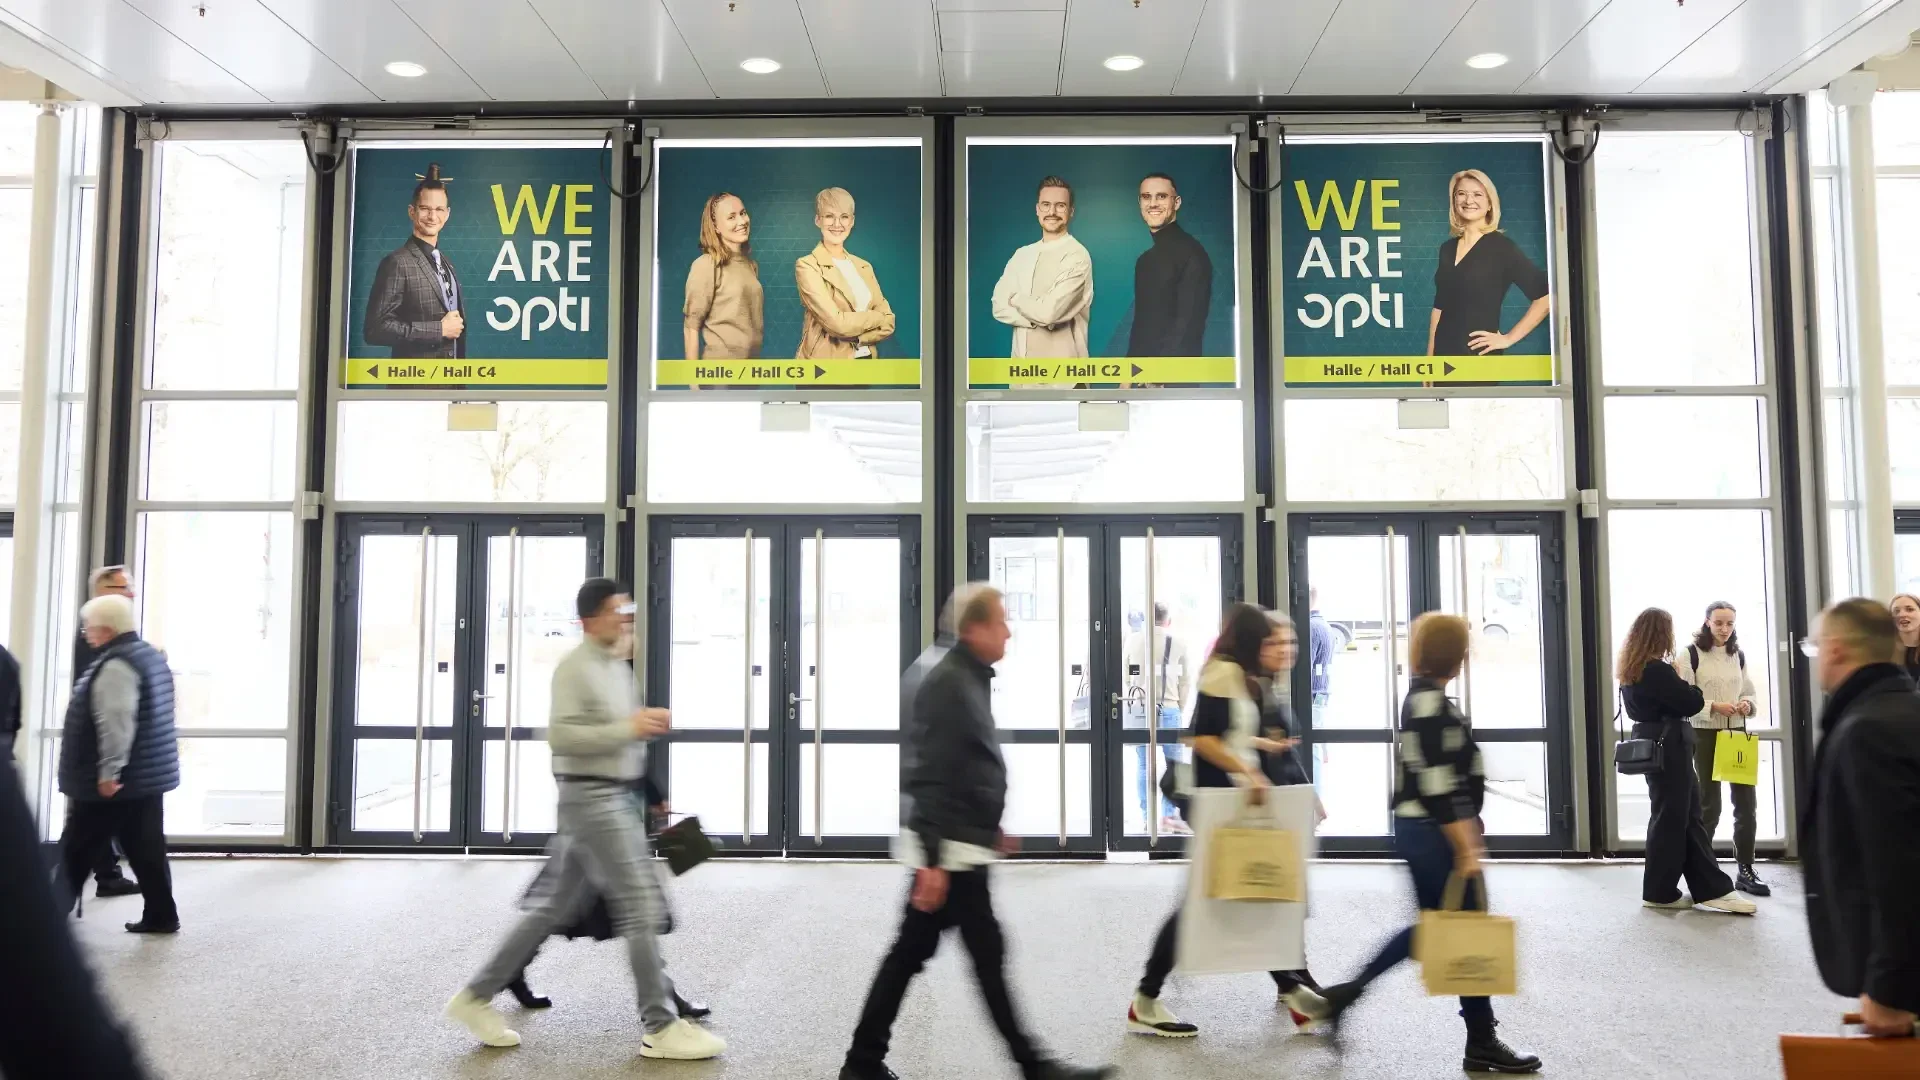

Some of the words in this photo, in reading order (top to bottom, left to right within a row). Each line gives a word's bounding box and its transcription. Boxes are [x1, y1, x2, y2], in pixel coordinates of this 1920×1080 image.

[491, 184, 593, 235] WE
[1294, 180, 1401, 231] WE
[488, 240, 592, 282] ARE
[1297, 236, 1403, 278] ARE
[486, 287, 590, 341] opti
[1297, 283, 1404, 338] opti
[388, 366, 425, 378] Halle
[431, 365, 438, 379] /
[443, 366, 472, 378] Hall
[477, 366, 496, 378] C4
[695, 366, 733, 379] Halle
[739, 365, 746, 380] /
[751, 366, 781, 379] Hall
[786, 366, 805, 379] C3
[1009, 364, 1048, 377] Halle
[1053, 363, 1061, 378] /
[1066, 364, 1096, 377] Hall
[1101, 364, 1121, 377] C2
[1323, 363, 1362, 376] Halle
[1368, 362, 1375, 377] /
[1381, 363, 1411, 376] Hall
[1416, 363, 1434, 376] C1
